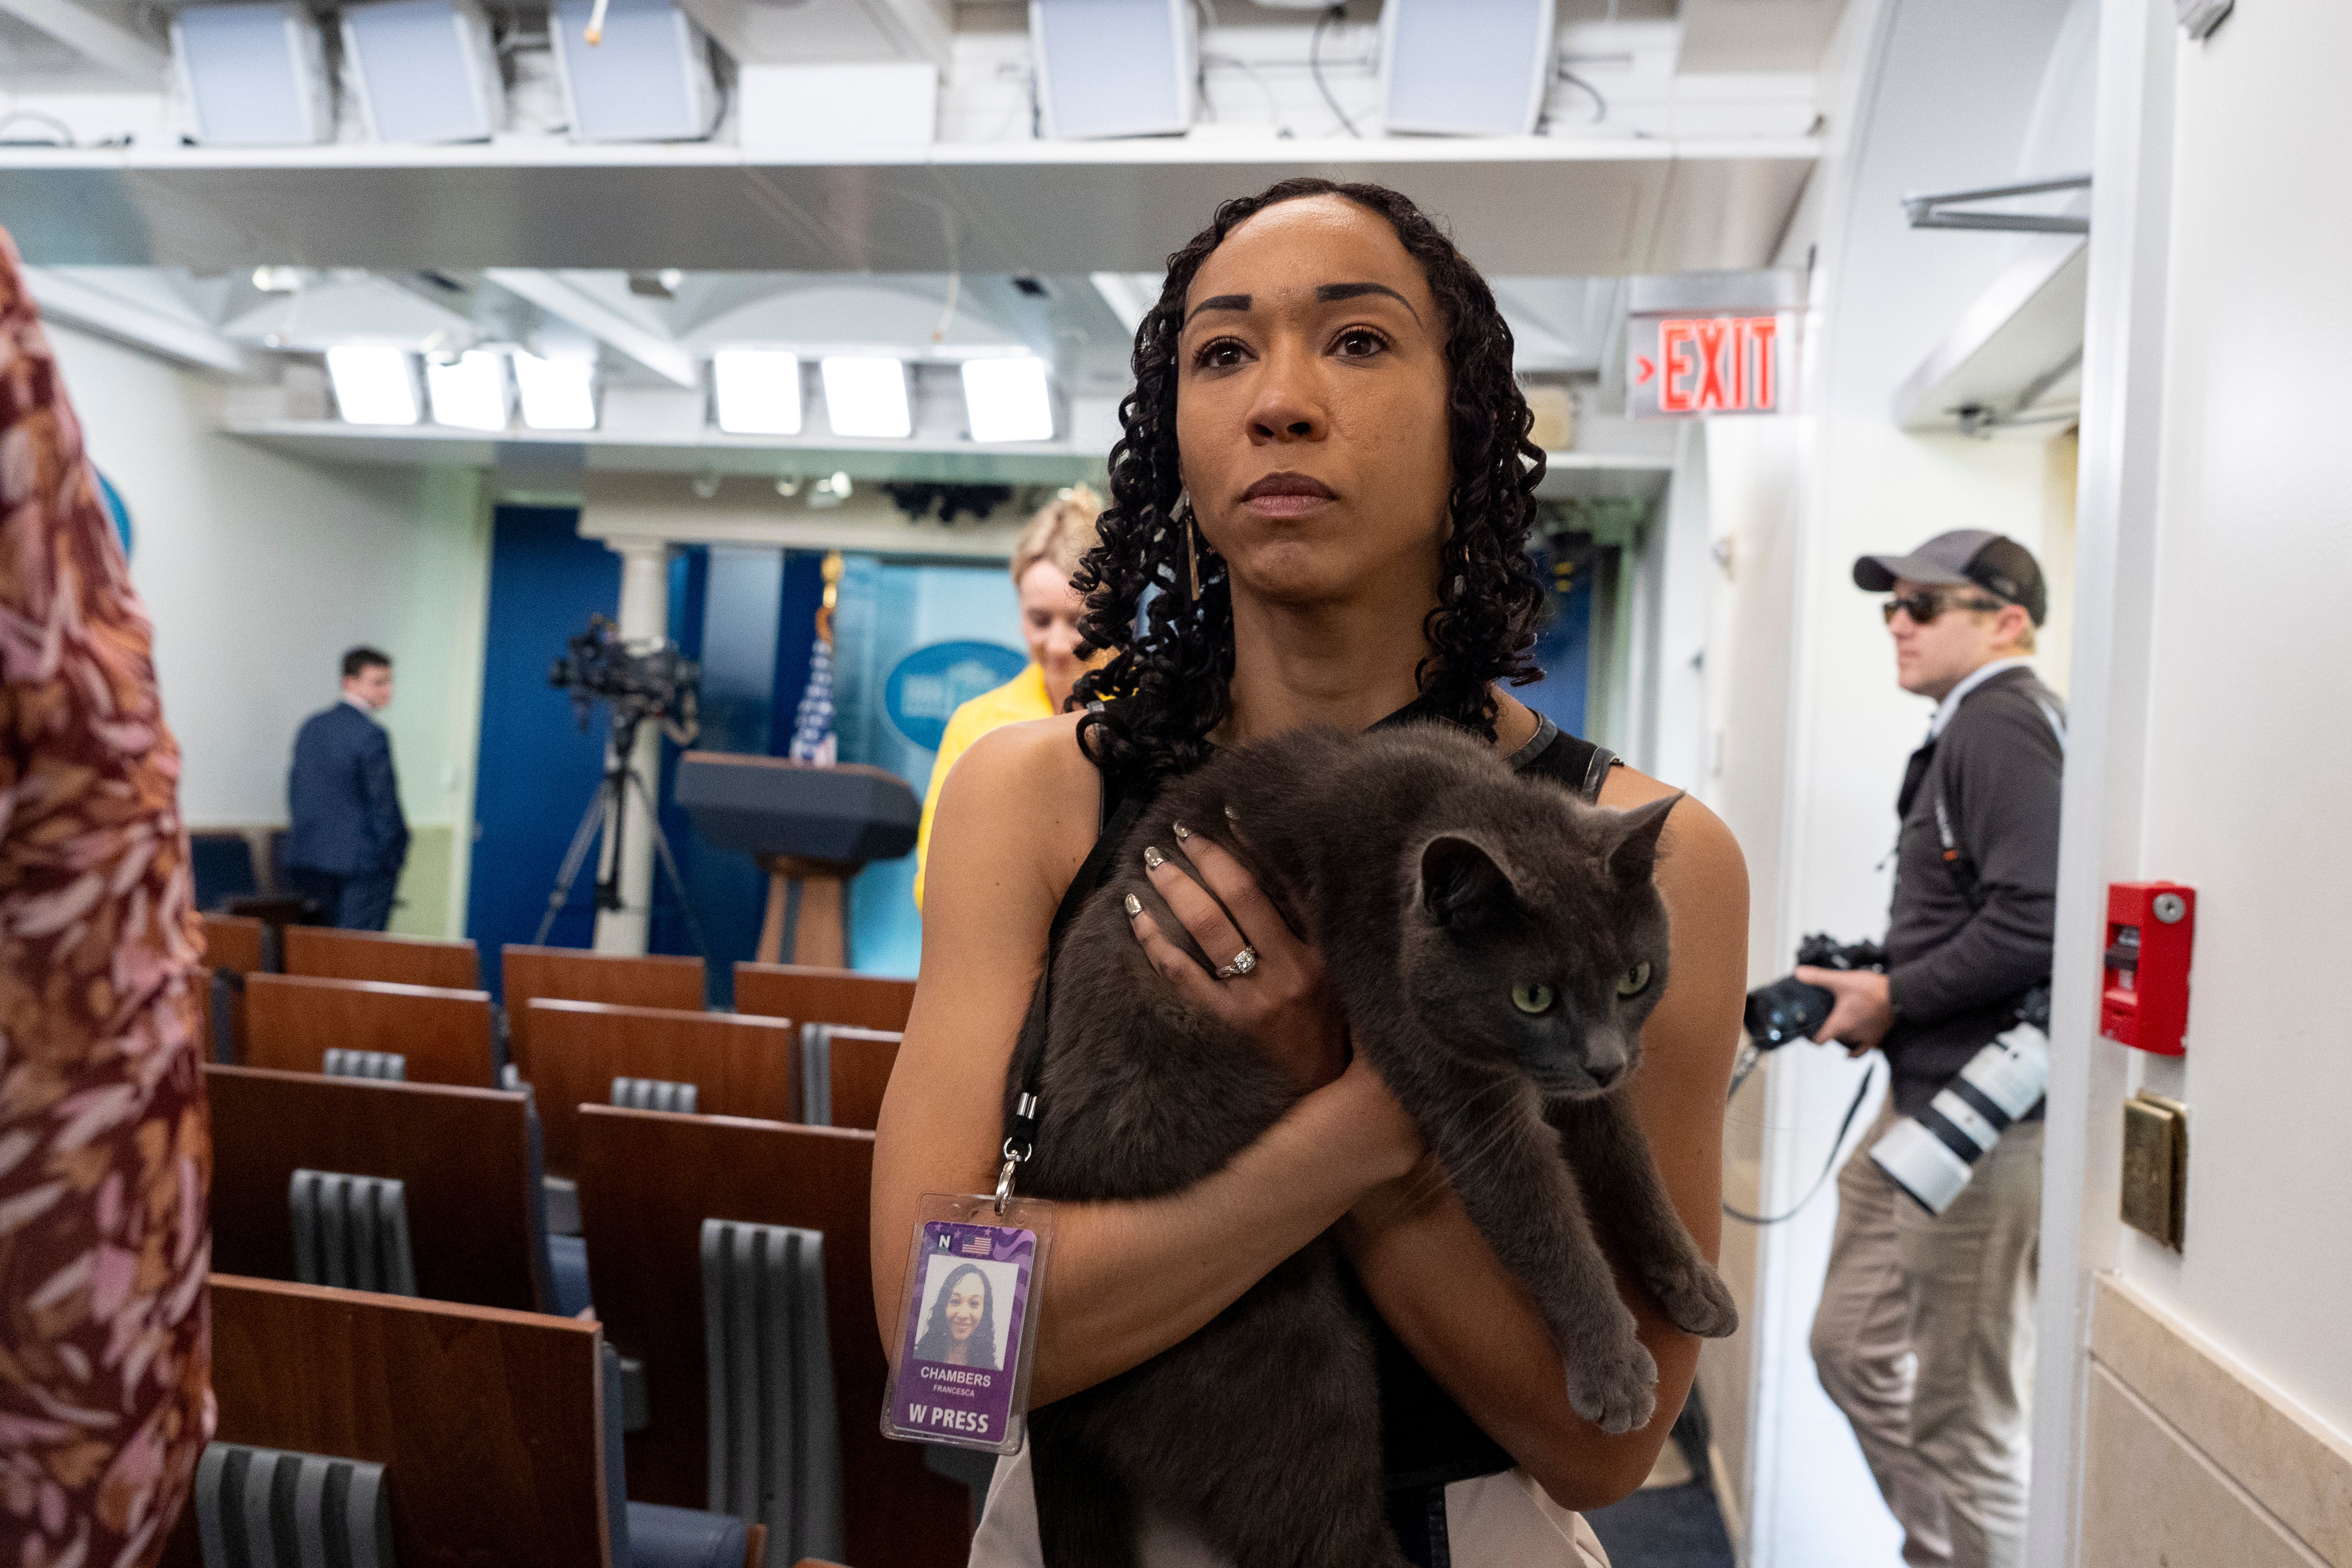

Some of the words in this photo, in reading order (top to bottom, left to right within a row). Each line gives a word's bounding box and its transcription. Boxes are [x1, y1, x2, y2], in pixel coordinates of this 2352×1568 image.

[1659, 316, 1778, 412] EXIT
[939, 1234, 951, 1248] N
[920, 1366, 991, 1387] CHAMBERS
[933, 1384, 975, 1397] FRANCESCA
[909, 1403, 928, 1423] W
[931, 1407, 989, 1433] PRESS
